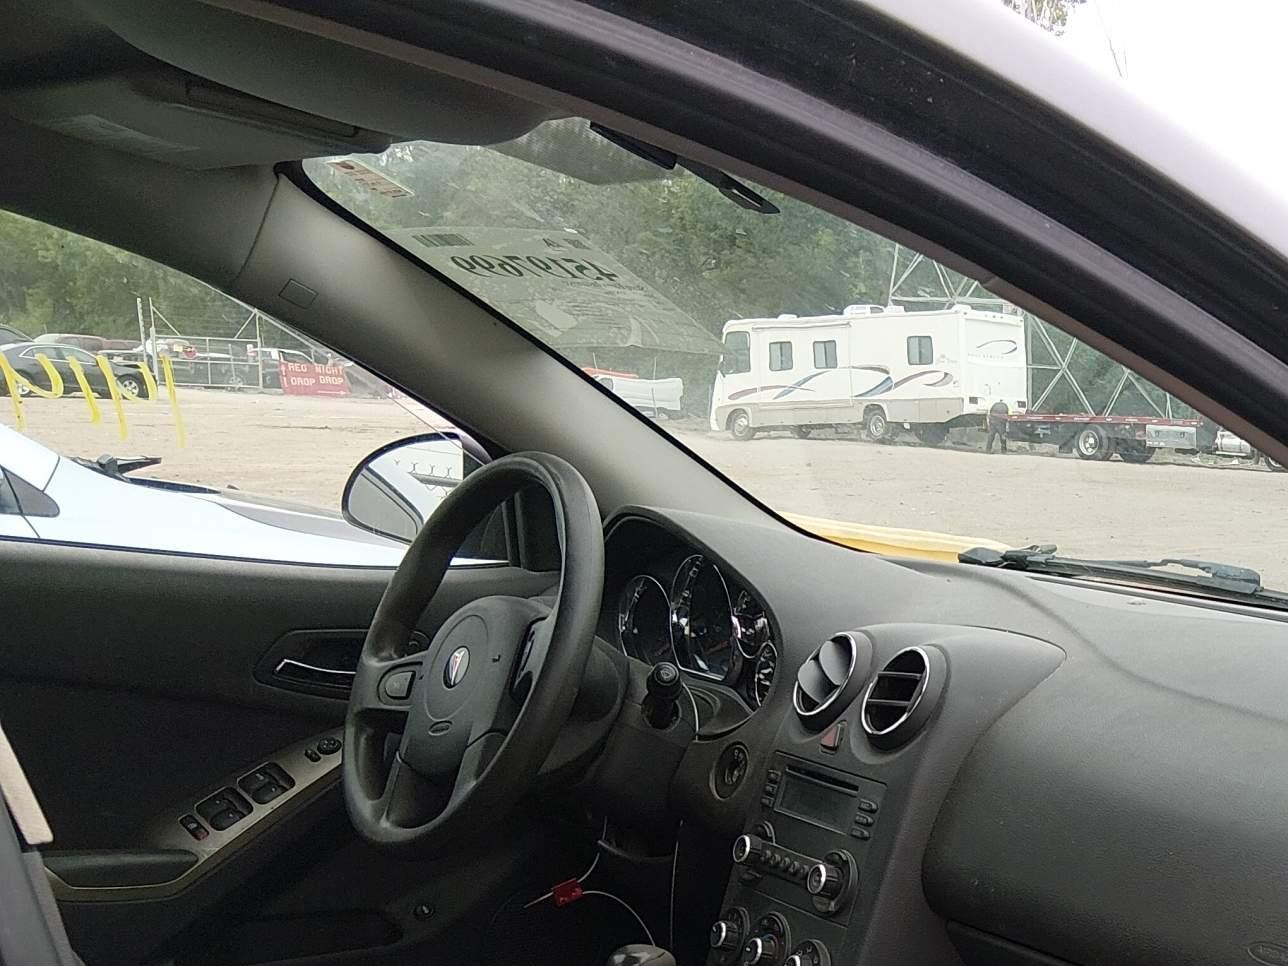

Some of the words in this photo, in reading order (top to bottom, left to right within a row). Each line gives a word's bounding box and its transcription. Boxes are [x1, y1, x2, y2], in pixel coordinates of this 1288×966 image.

[314, 364, 342, 374] NIGHT
[290, 377, 315, 386] DROP
[319, 376, 344, 385] DROP
